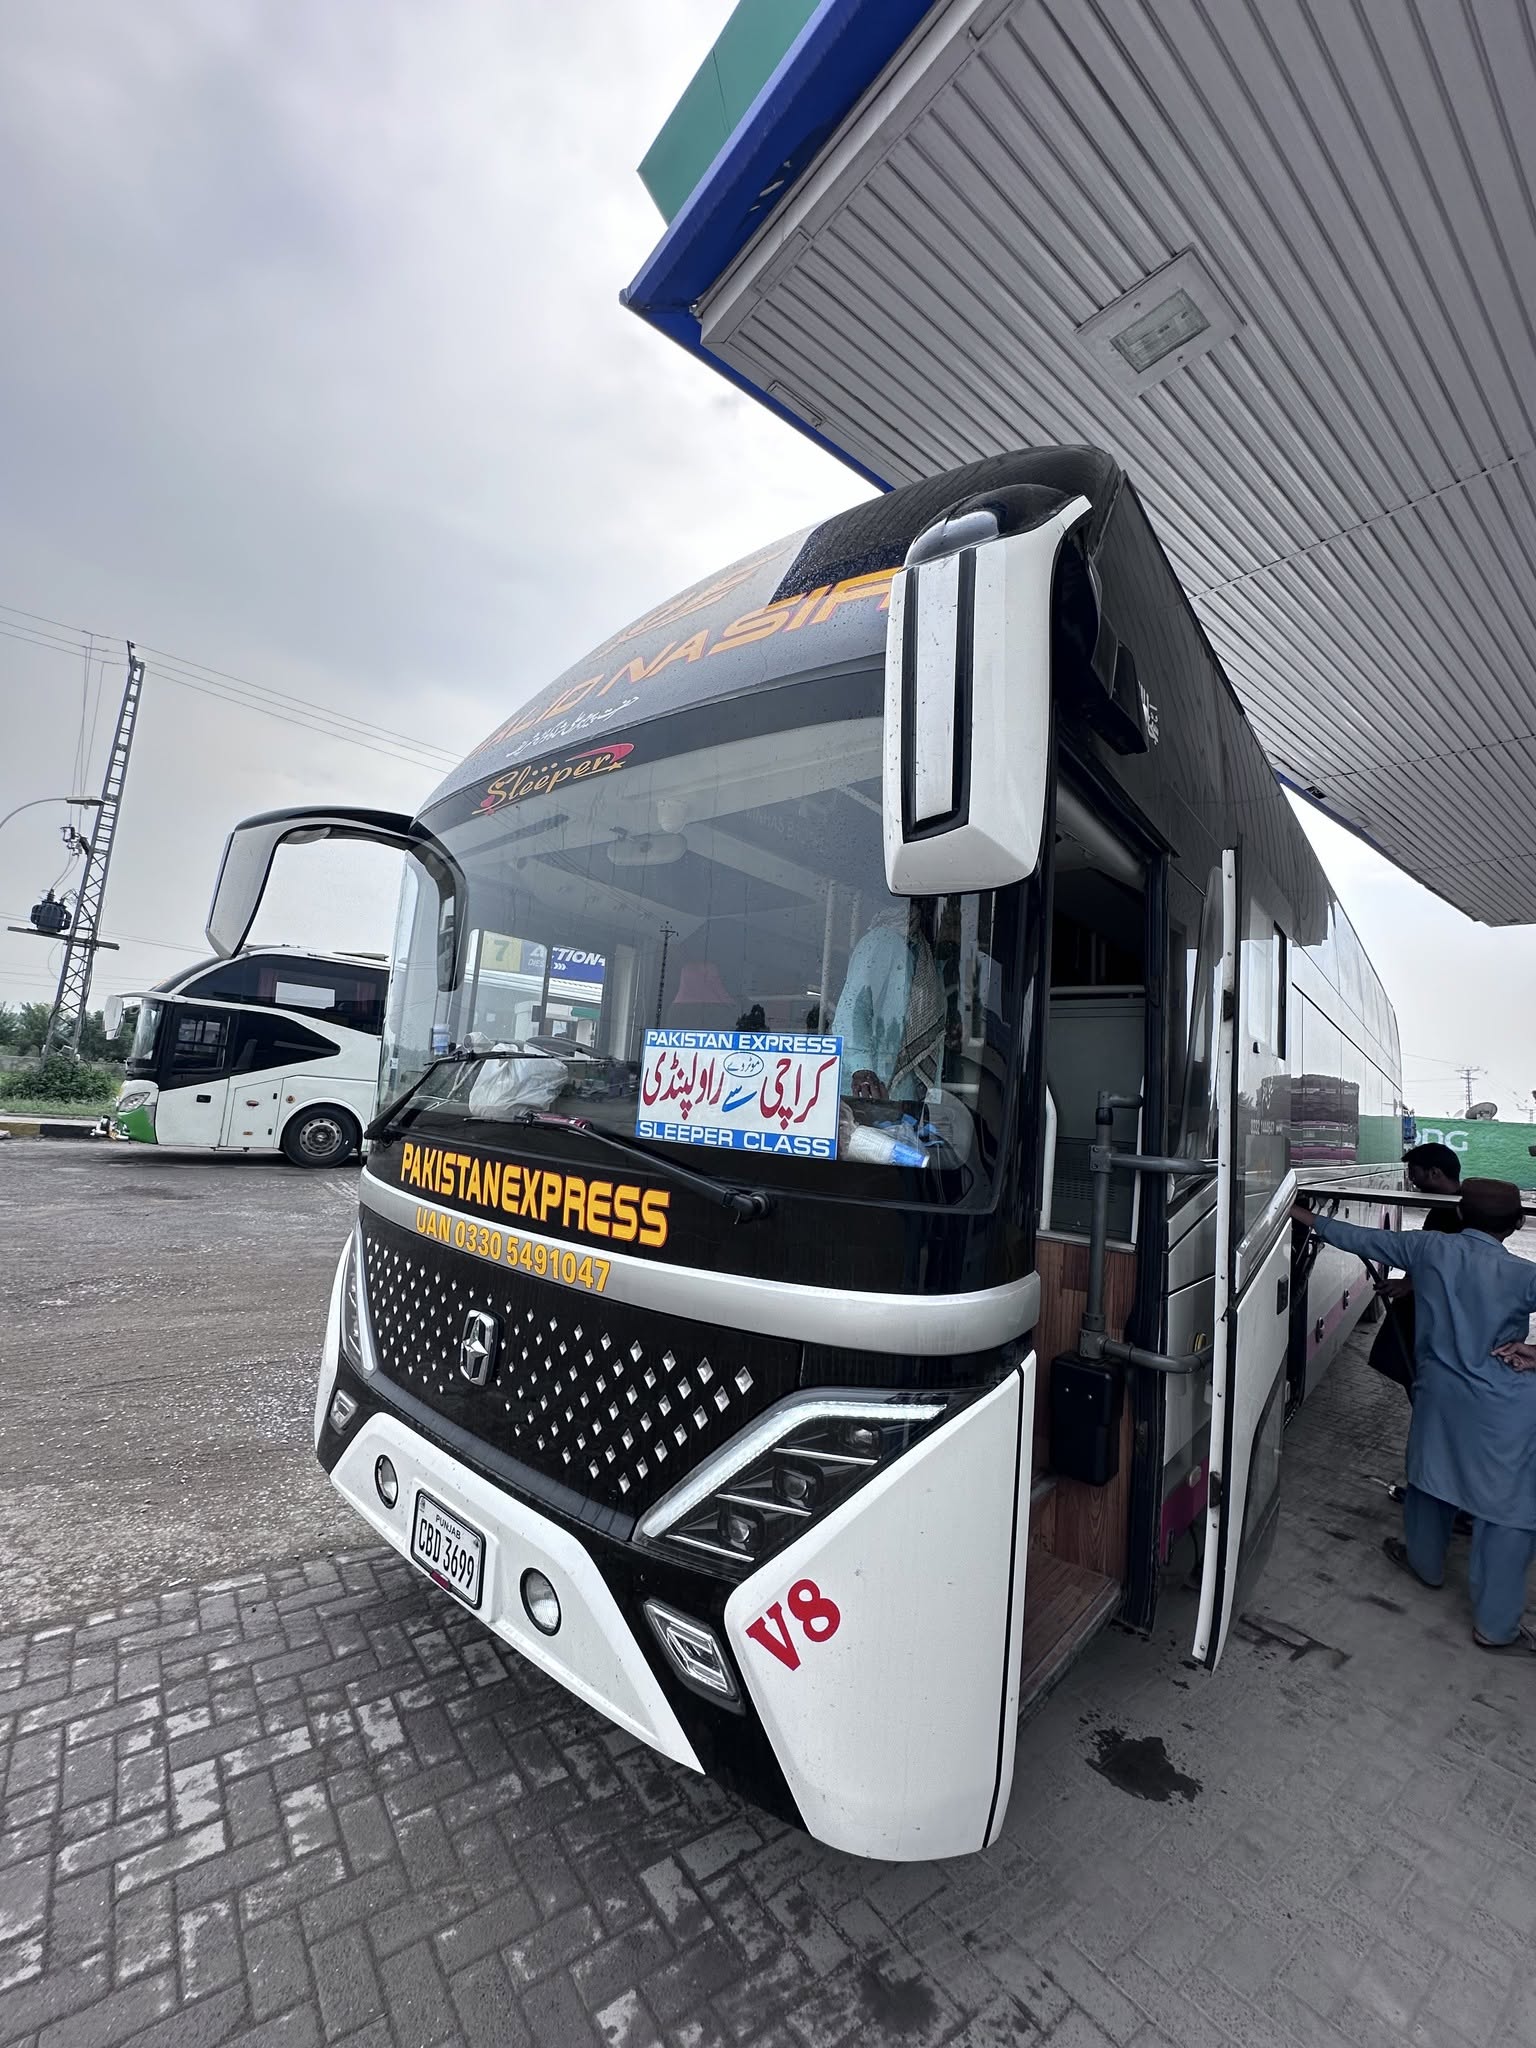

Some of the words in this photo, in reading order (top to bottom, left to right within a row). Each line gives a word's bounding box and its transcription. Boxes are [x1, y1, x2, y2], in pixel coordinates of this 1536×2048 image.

[646, 1031, 733, 1049] PAKISTAN
[738, 1034, 837, 1054] EXPRESS
[643, 1051, 725, 1121] راولپنڈی
[721, 1085, 758, 1113] سے
[760, 1056, 838, 1131] کراچی
[639, 1121, 734, 1147] SLEEPER
[743, 1133, 831, 1156] CLASS
[416, 1206, 452, 1243] UAN
[454, 1220, 502, 1260] 0330
[506, 1236, 612, 1293] 5491047
[418, 1518, 442, 1563] CBD
[443, 1535, 475, 1590] 3699
[435, 1514, 462, 1540] PUNJAB
[745, 1578, 841, 1671] V8
